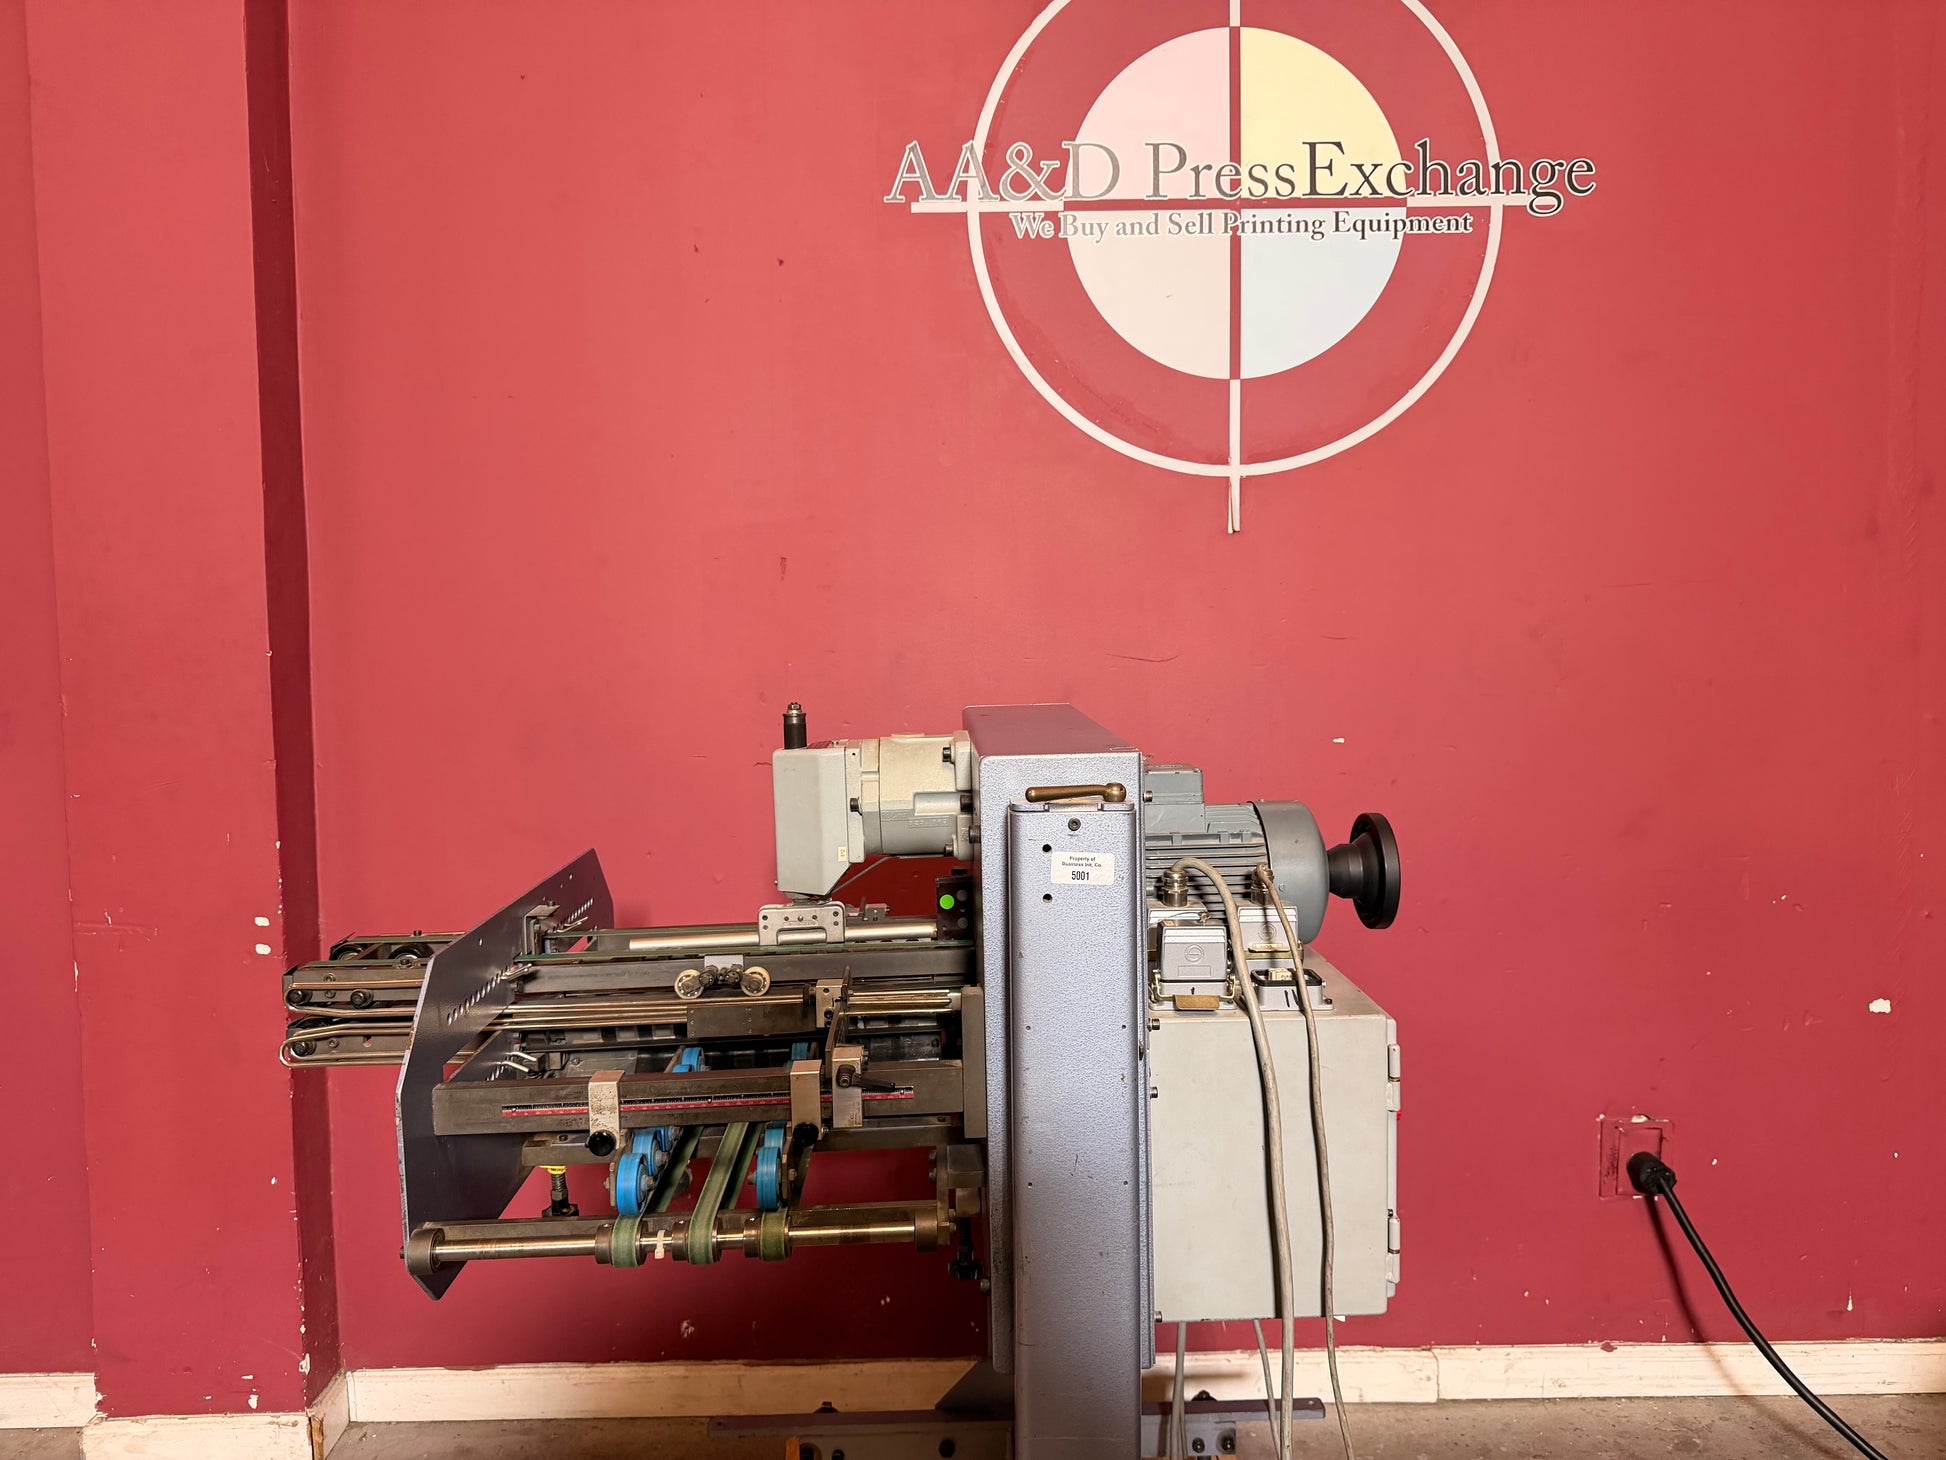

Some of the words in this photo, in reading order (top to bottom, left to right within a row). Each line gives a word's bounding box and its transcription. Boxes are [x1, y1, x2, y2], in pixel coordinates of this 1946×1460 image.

[884, 139, 1120, 202] AA&D
[1144, 138, 1597, 217] PressExchange
[1009, 212, 1055, 240] We
[1058, 211, 1109, 244] Buy
[1115, 211, 1164, 237] and
[1167, 211, 1214, 236] Sell
[1220, 211, 1327, 242] Printing
[1332, 210, 1473, 241] Equipment
[1071, 870, 1090, 881] 5001
